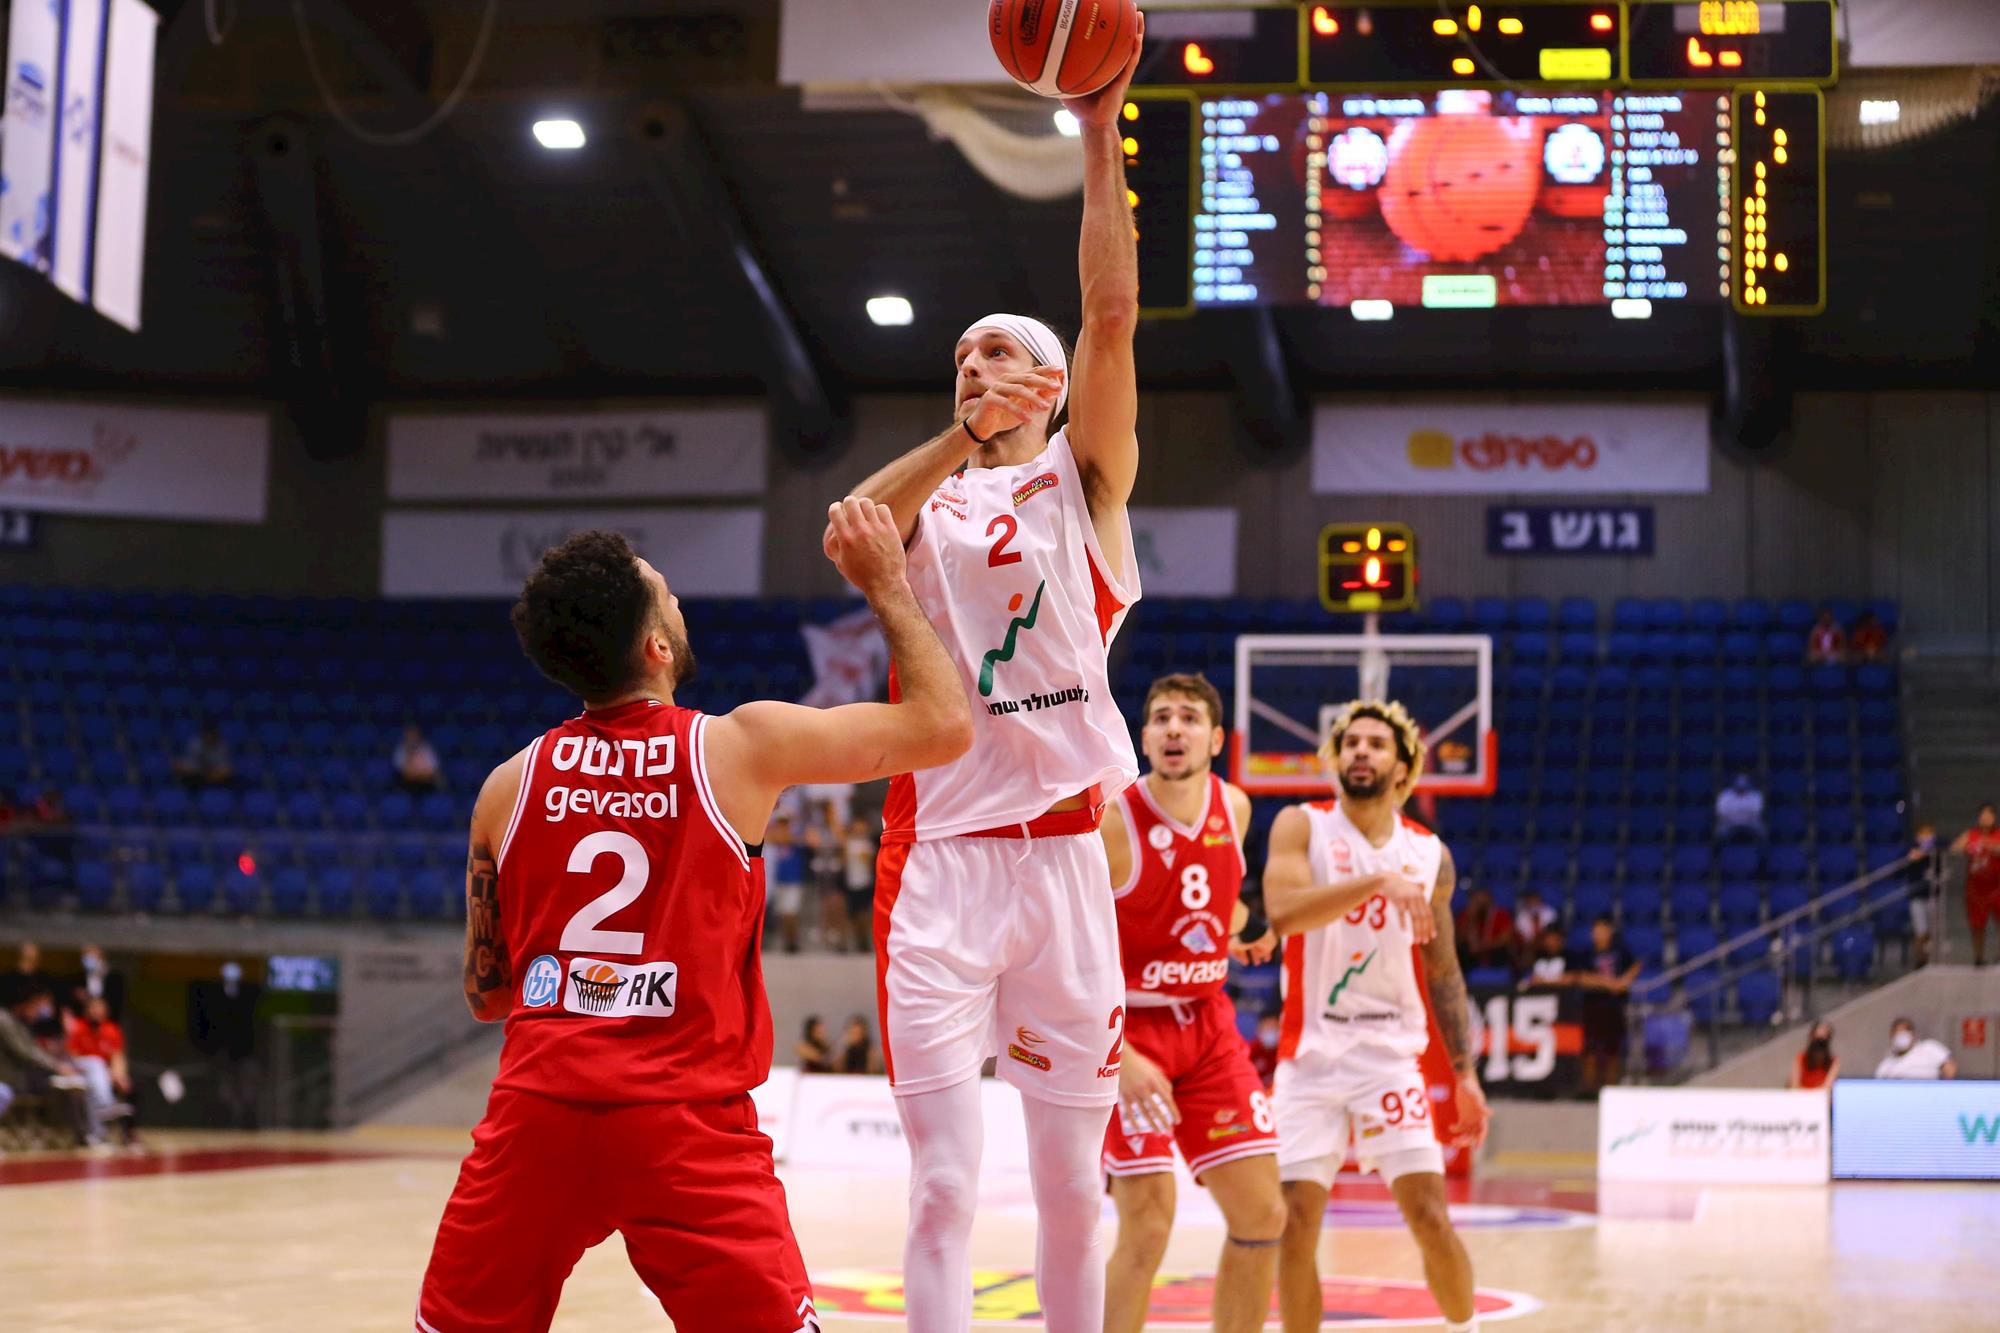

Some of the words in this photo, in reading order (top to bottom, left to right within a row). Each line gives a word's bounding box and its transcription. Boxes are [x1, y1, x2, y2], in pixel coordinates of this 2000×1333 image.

[985, 514, 1022, 568] 2
[1501, 512, 1532, 548] ב
[1550, 512, 1641, 549] גוש
[551, 735, 675, 777] פרנטס
[545, 784, 678, 822] gevasol
[559, 831, 650, 955] 2
[1181, 864, 1211, 910] 8
[626, 971, 674, 1007] RK
[1141, 957, 1229, 989] gevaso
[1105, 1005, 1124, 1066] 2
[1469, 996, 1559, 1081] 15
[1097, 1066, 1121, 1079] Kem
[1250, 1090, 1277, 1133] 8
[1381, 1088, 1427, 1125] 93
